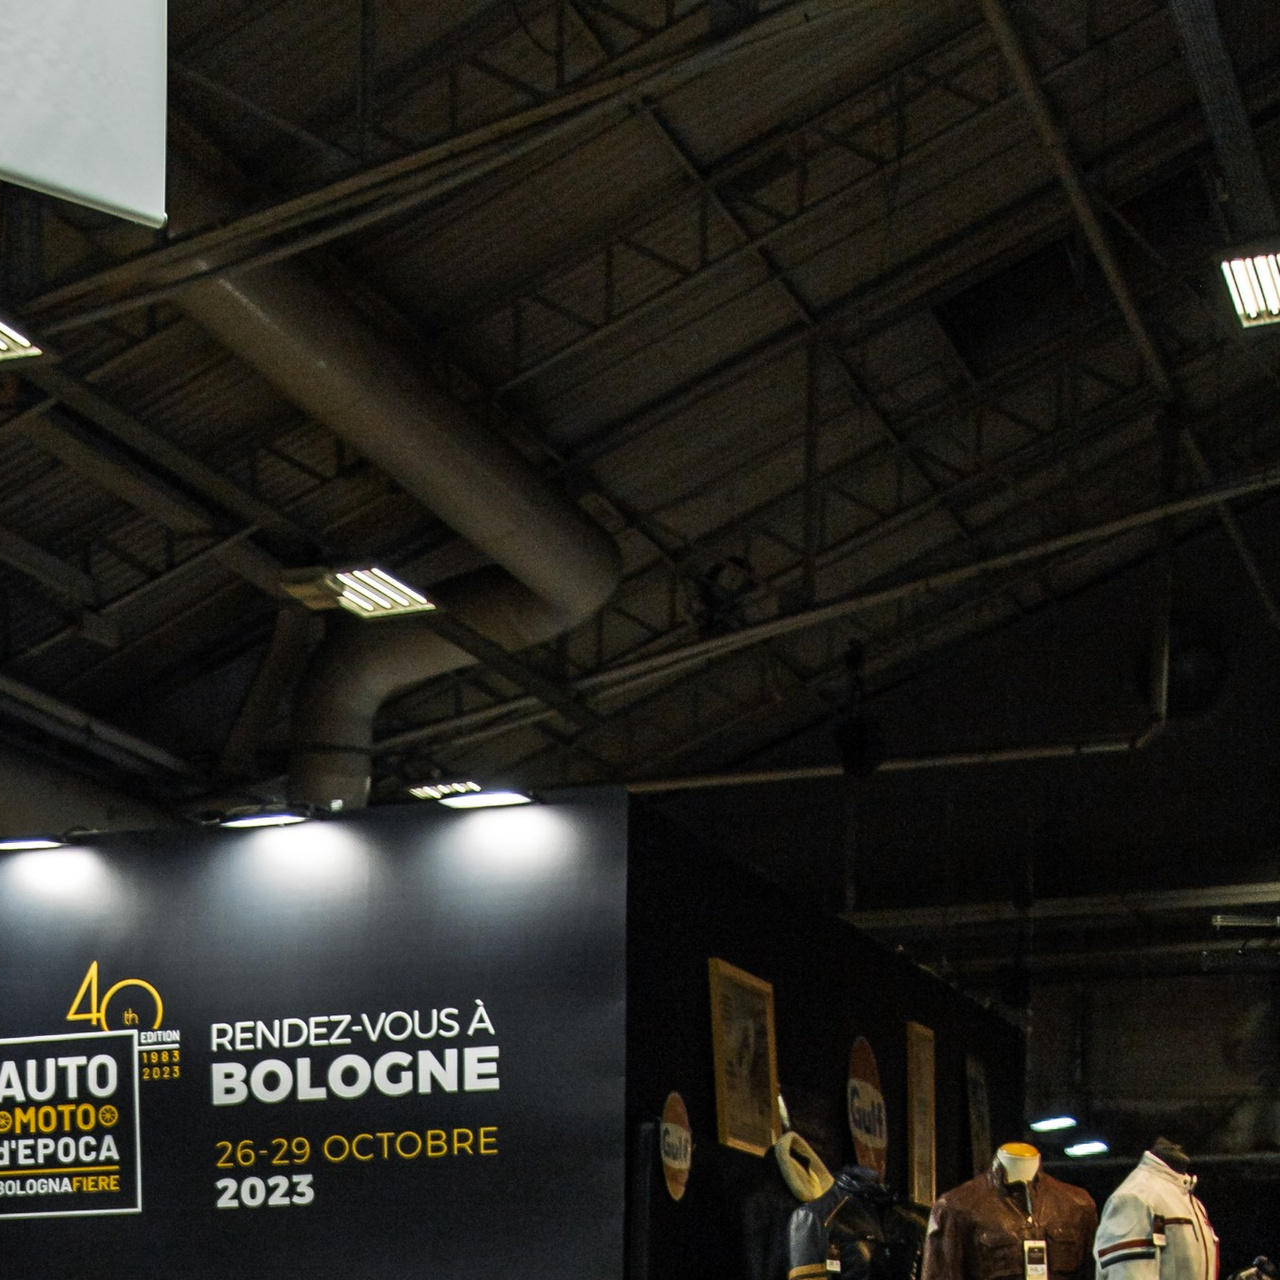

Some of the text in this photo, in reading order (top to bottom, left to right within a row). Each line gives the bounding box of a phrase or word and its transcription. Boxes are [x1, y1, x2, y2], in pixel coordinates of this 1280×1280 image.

[140, 1030, 180, 1044] EDITION
[210, 1000, 495, 1052] RENDEZ-VOUS À
[142, 1050, 180, 1064] 1983
[142, 1066, 180, 1080] 2023
[212, 1045, 500, 1106] BOLOGNE
[14, 1103, 96, 1134] MOTO
[215, 1126, 499, 1168] 26-29 OCTOBRE
[216, 1174, 315, 1208] 2023
